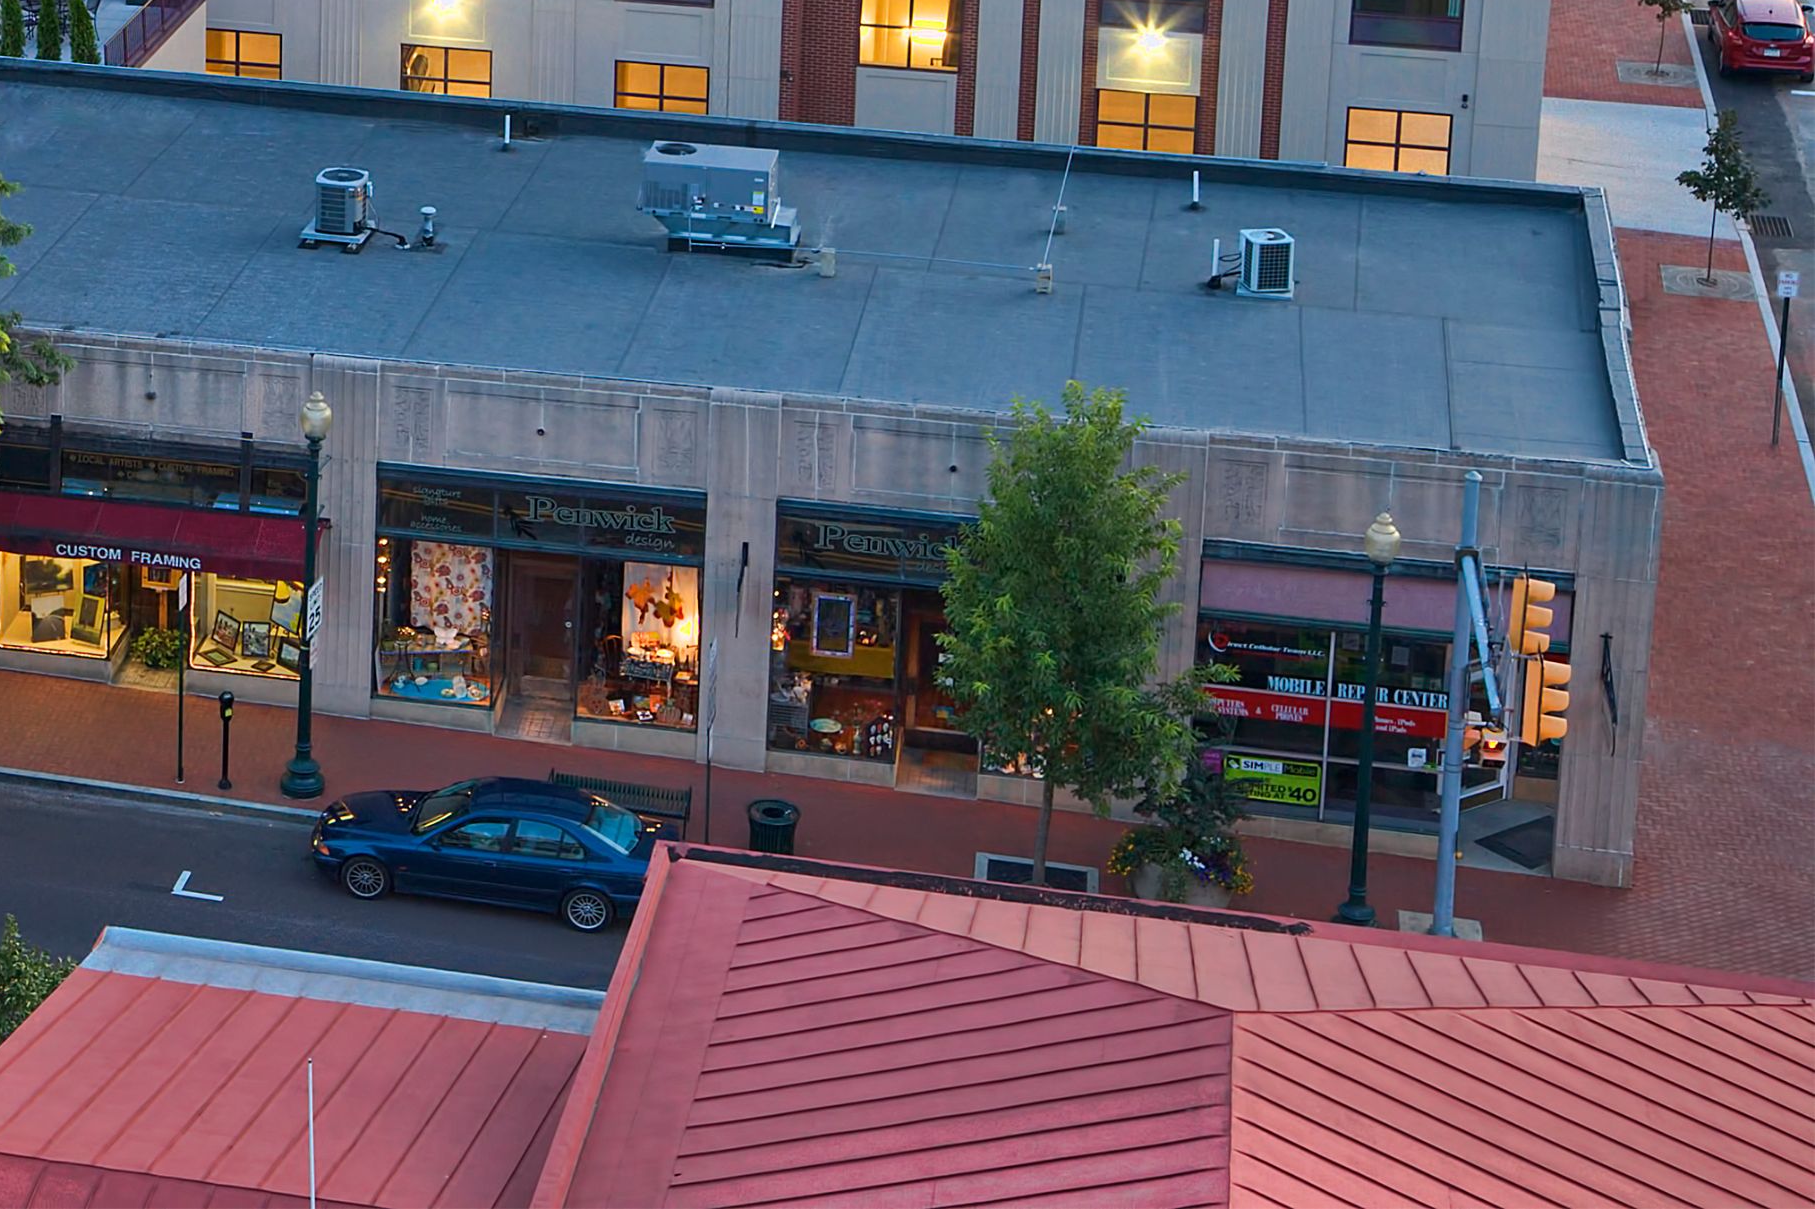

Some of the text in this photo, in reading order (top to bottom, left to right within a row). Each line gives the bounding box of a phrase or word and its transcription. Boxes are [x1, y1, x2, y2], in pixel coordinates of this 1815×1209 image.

[525, 495, 676, 534] Penwick
[625, 532, 675, 550] design
[56, 544, 201, 570] CUSTOM FRAMING
[308, 605, 321, 633] 25
[1267, 675, 1448, 709] MOBILE REPIR CENTER
[1270, 704, 1309, 715] CELLULAR
[1243, 760, 1316, 776] SIMPLE Mobile
